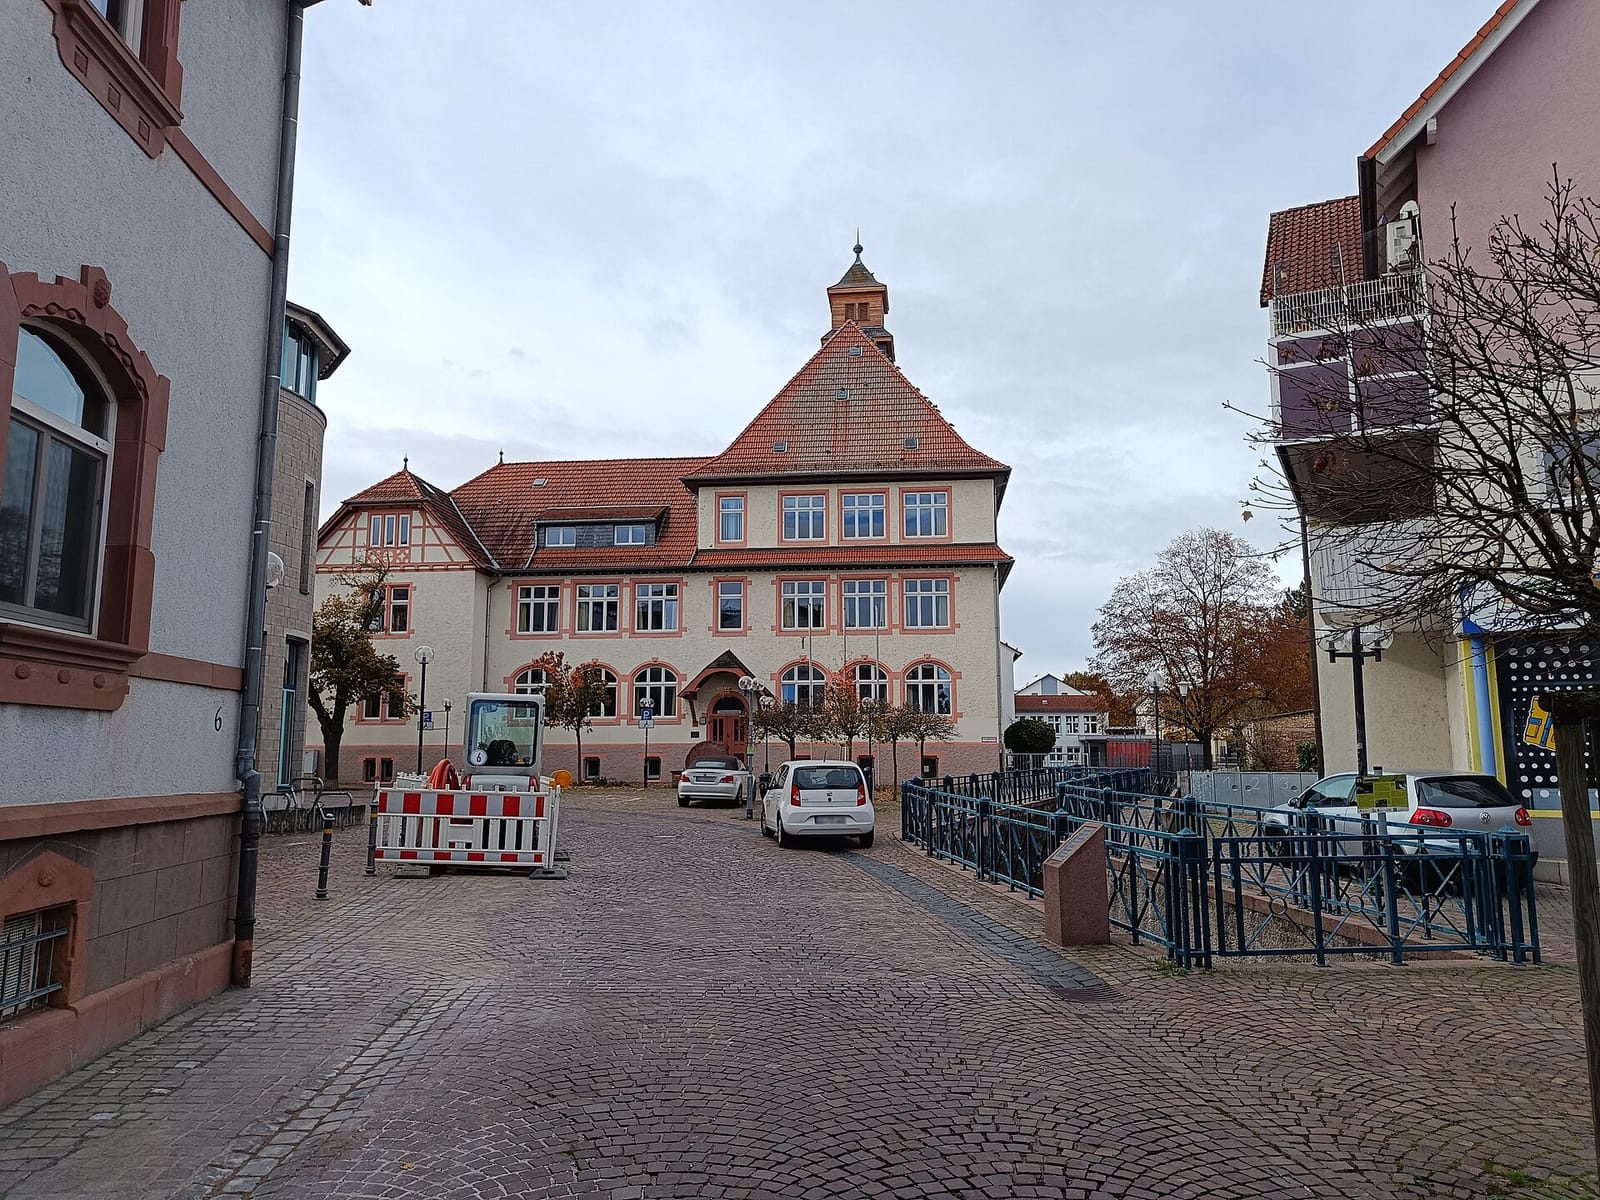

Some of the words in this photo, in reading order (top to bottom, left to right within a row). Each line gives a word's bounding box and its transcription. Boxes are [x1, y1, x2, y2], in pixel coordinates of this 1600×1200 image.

[214, 705, 222, 732] 6
[643, 710, 650, 720] P
[476, 751, 482, 763] 6
[1252, 776, 1260, 790] 2
[1280, 777, 1289, 790] 3
